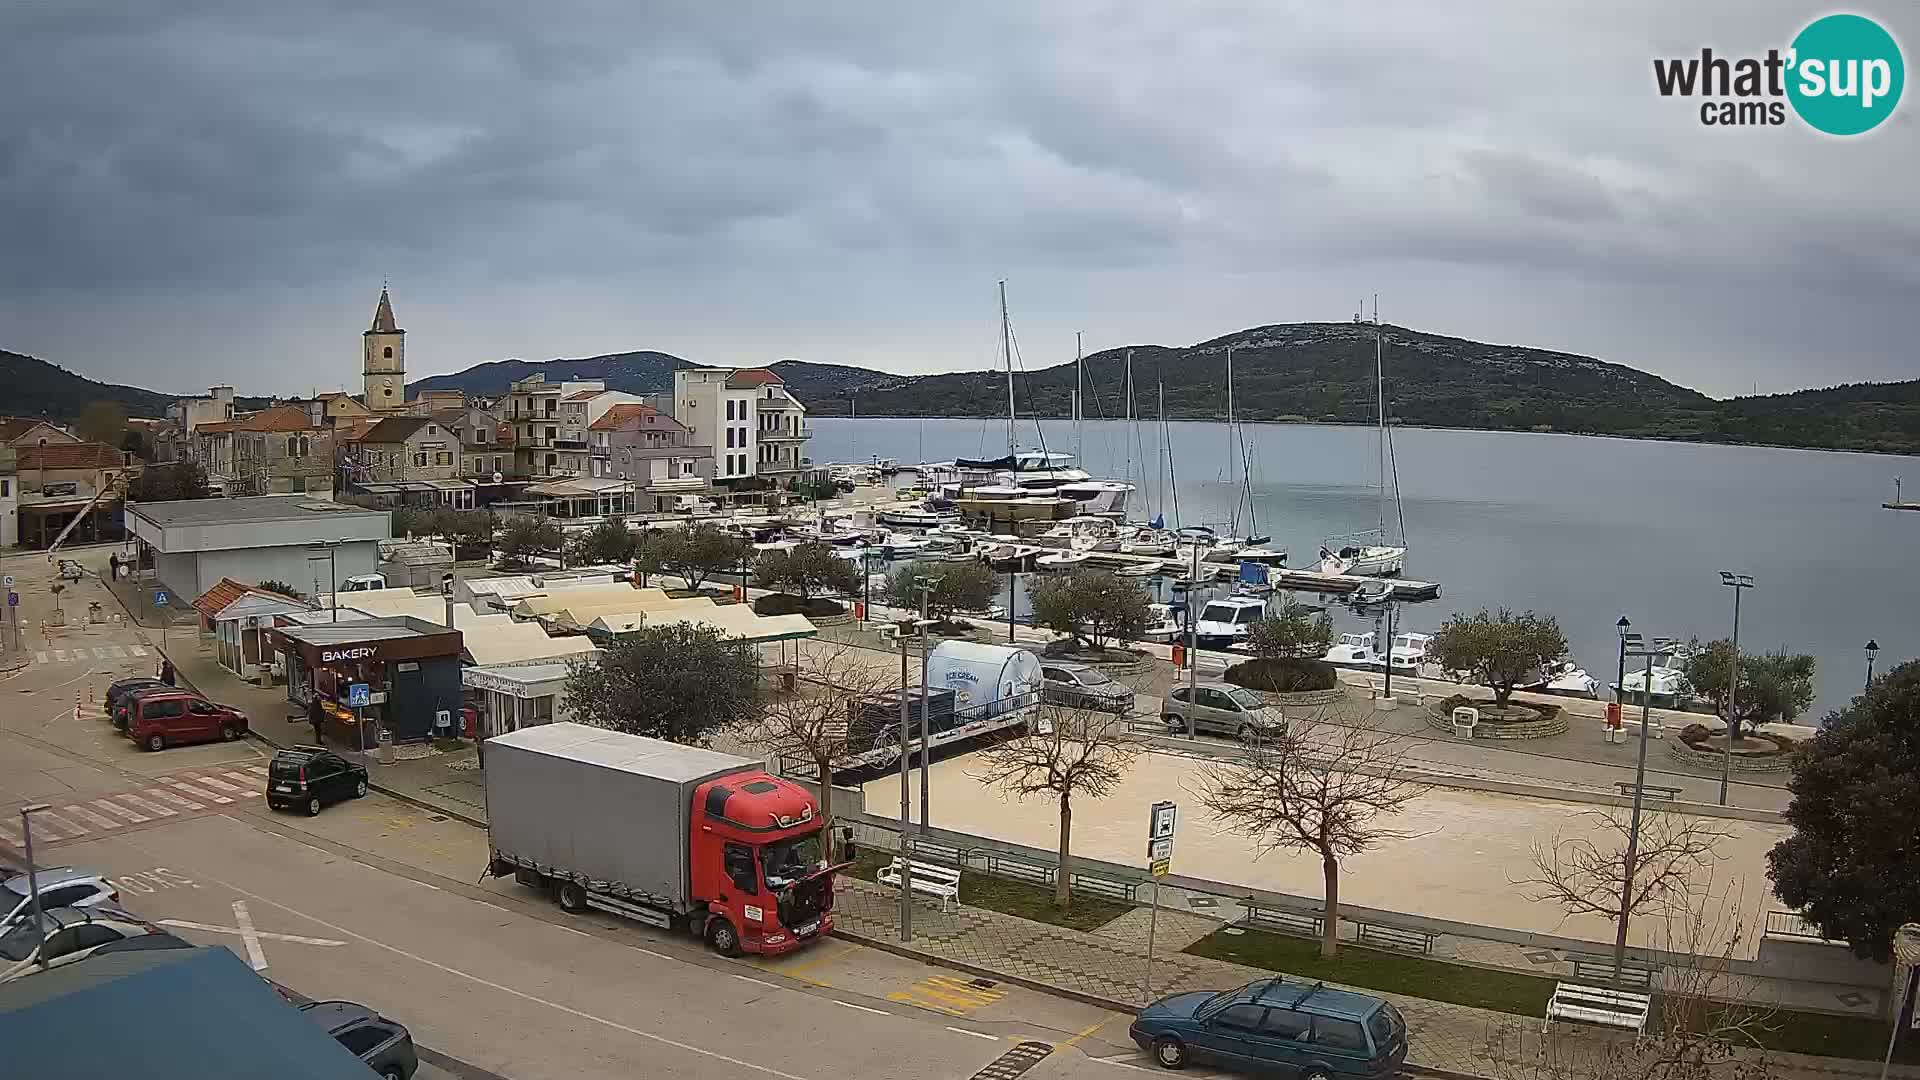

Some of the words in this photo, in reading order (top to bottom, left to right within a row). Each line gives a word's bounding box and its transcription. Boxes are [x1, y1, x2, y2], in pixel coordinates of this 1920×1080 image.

[322, 647, 377, 661] BAKERY
[946, 672, 957, 681] ICE
[957, 672, 979, 684] CREAM
